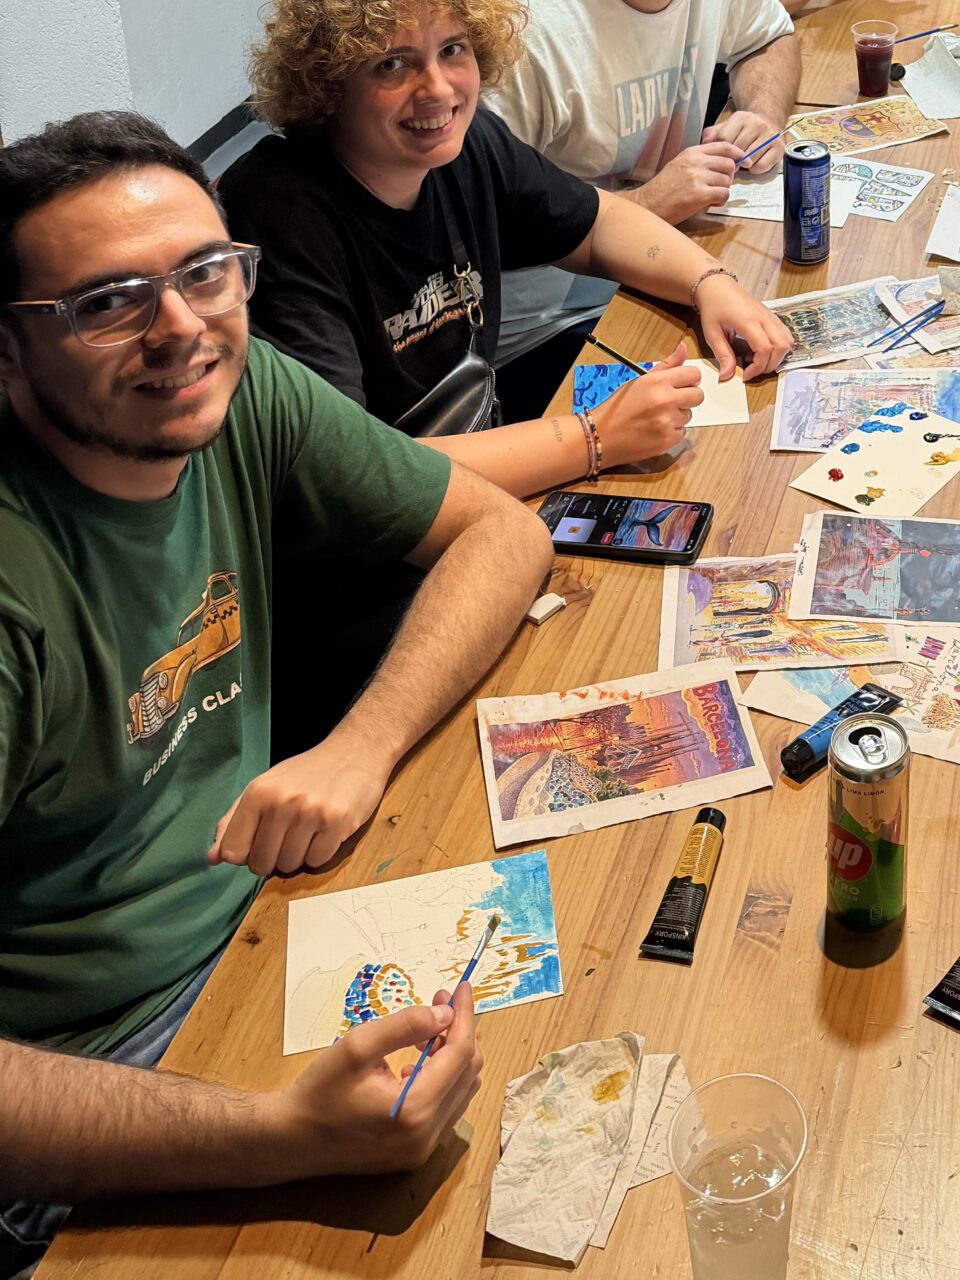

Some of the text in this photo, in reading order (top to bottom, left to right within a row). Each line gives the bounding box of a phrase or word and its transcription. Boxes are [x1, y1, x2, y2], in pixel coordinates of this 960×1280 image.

[616, 71, 669, 138] LADY
[142, 671, 243, 787] BUSINESS CLA
[692, 683, 738, 771] BARCELONA
[654, 929, 689, 942] KINSPORY
